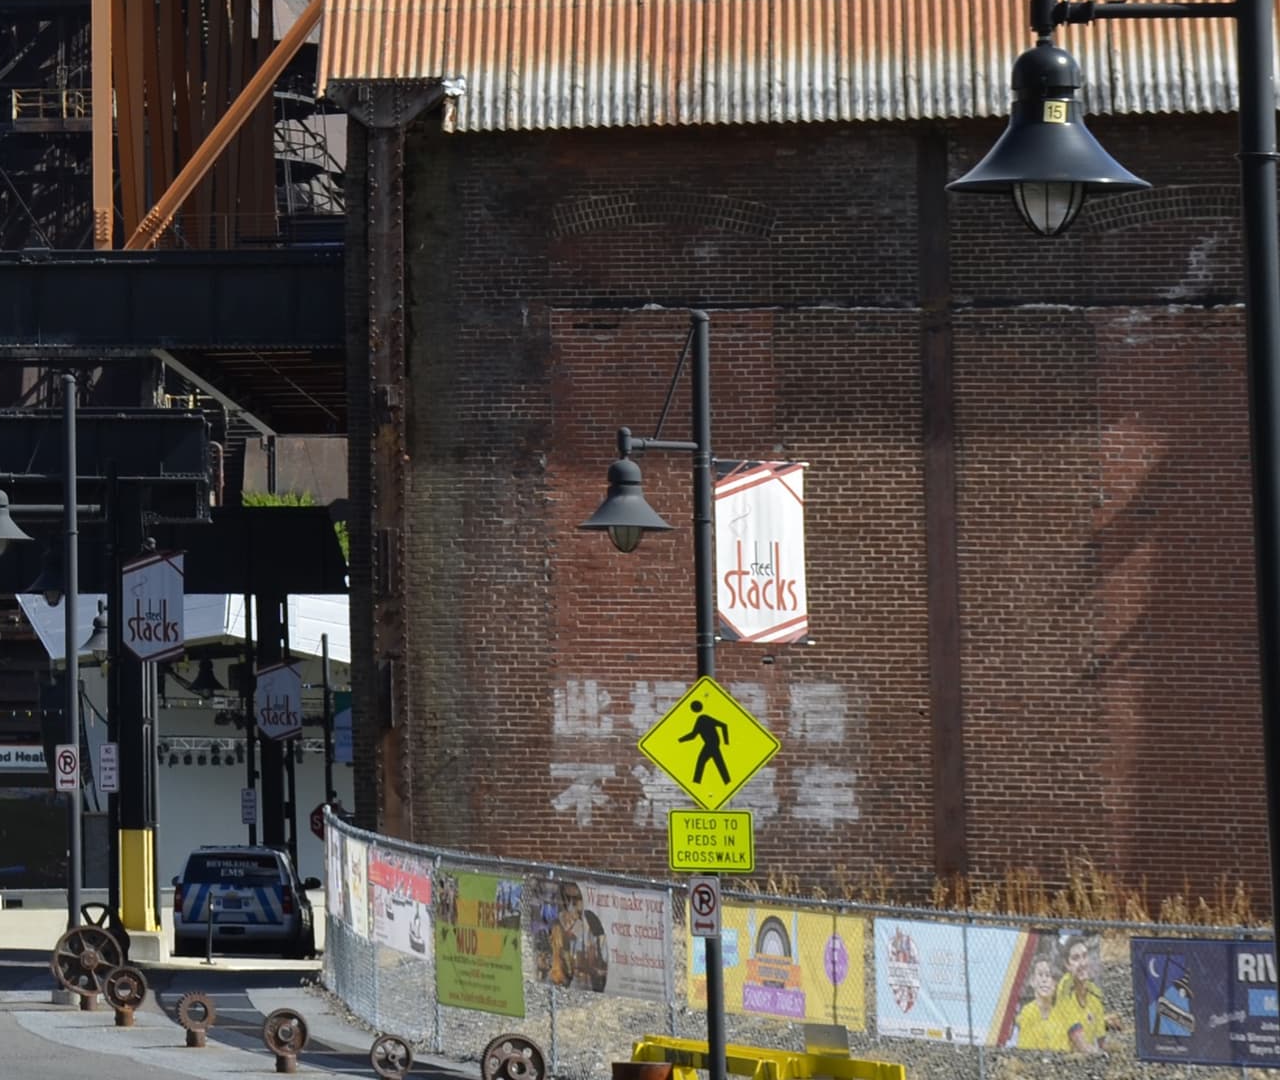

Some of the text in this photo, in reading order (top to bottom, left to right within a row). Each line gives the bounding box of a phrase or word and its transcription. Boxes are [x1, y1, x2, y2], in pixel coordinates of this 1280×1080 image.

[1047, 104, 1063, 120] 15
[750, 540, 775, 577] steel
[724, 539, 799, 611] stacks
[127, 597, 179, 643] stacks
[144, 597, 162, 622] steel
[260, 694, 299, 727] stacks
[683, 818, 739, 831] YIELD TO
[687, 834, 736, 847] PEDS IN
[676, 850, 747, 864] CROSSWALK
[220, 869, 245, 878] EMS
[586, 886, 610, 909] Want
[620, 890, 643, 912] make
[456, 927, 478, 955] MUD
